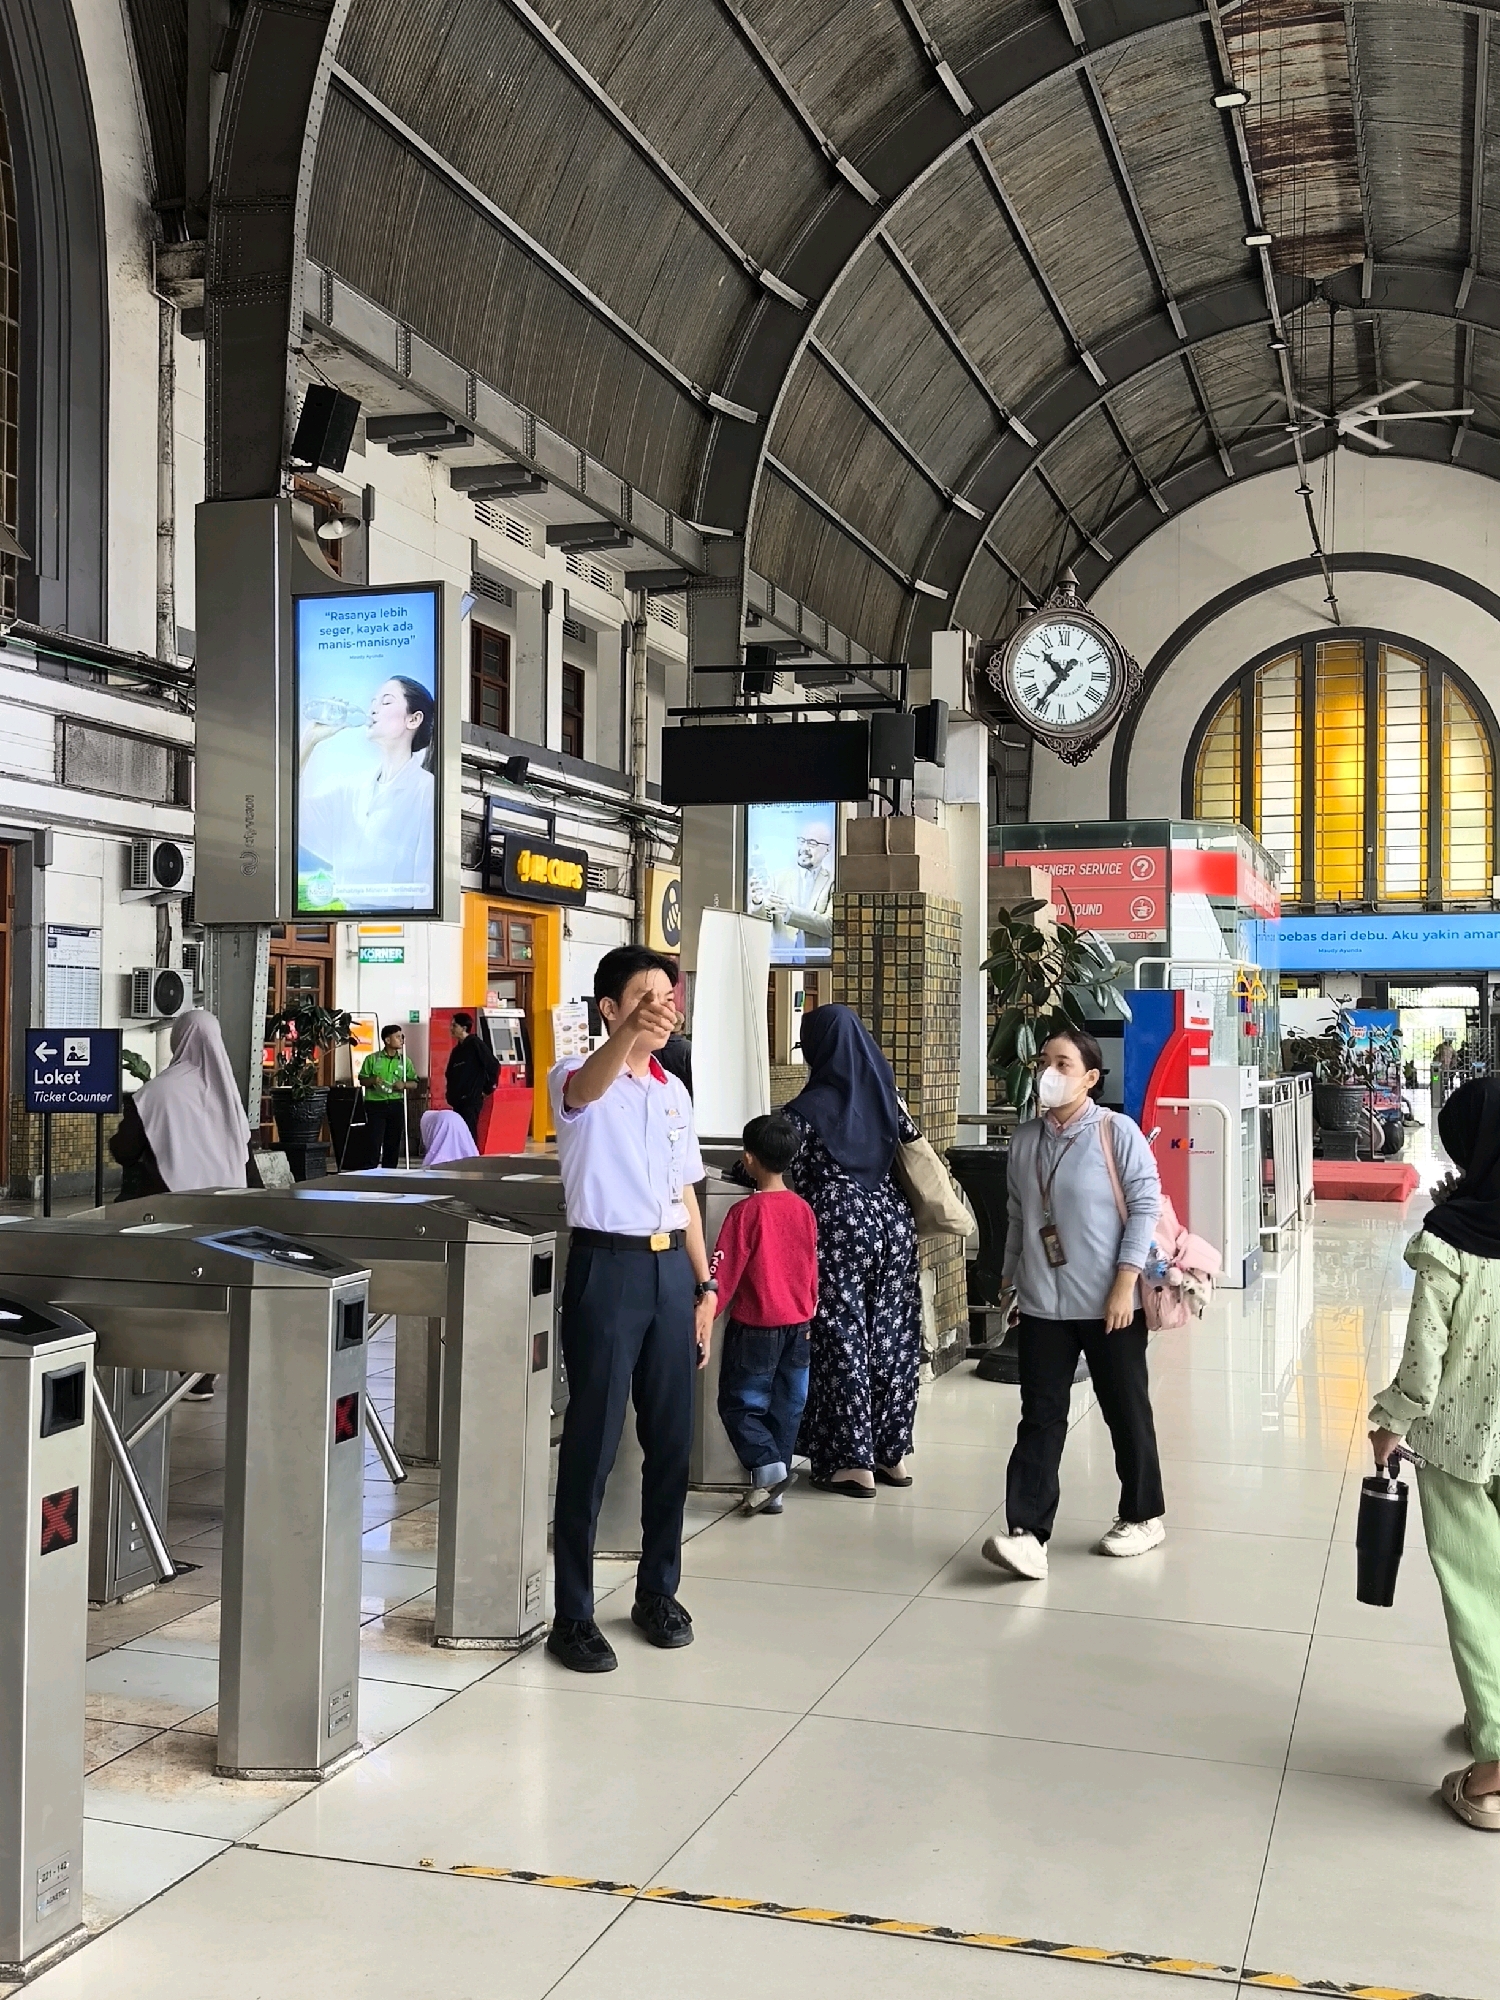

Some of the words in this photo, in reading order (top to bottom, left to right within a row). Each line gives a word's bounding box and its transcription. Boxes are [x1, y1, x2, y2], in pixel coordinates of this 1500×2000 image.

[380, 606, 408, 618] lebih
[319, 625, 354, 637] seger,
[356, 623, 389, 635] kayak
[392, 621, 413, 632] ada
[1078, 863, 1124, 875] SERVICE
[1321, 930, 1347, 941] dari
[1350, 930, 1388, 941] debu.
[1392, 930, 1419, 941] Aku
[1422, 929, 1460, 942] yakin
[360, 948, 403, 960] KÖRNER
[34, 1068, 81, 1085] Loket
[34, 1091, 66, 1102] Ticket
[68, 1091, 112, 1102] Counter
